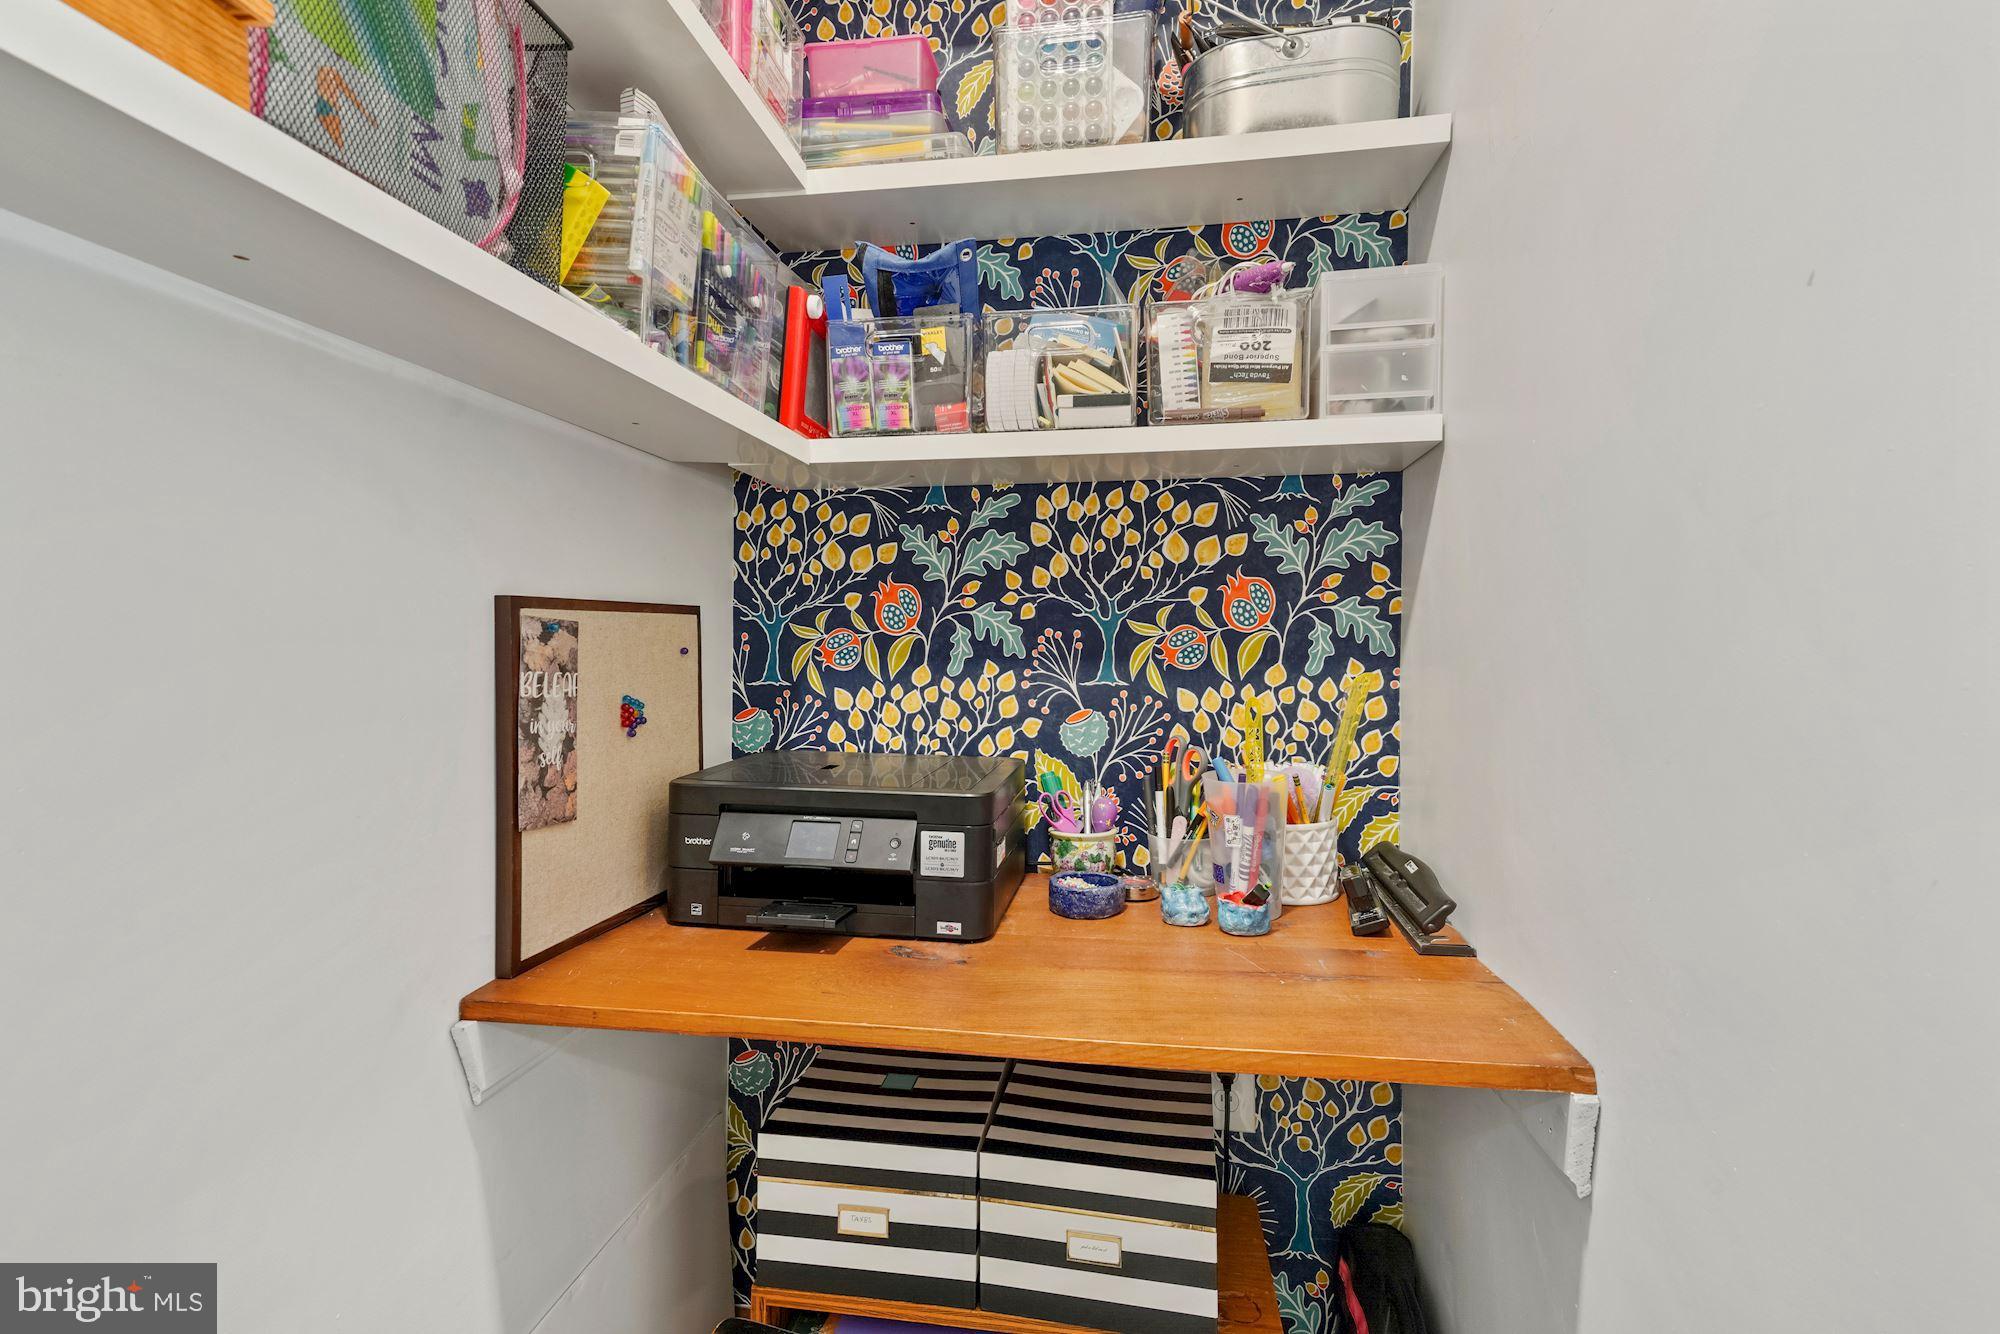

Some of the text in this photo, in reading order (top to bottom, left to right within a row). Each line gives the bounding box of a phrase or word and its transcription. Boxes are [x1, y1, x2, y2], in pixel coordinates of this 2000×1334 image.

[835, 346, 862, 354] brother
[877, 344, 905, 352] brother
[1239, 340, 1272, 351] 200
[1223, 353, 1280, 361] Superior Bond
[529, 718, 577, 741] in your
[539, 745, 564, 771] self
[684, 836, 712, 846] brother
[928, 838, 957, 851] genuine
[850, 1214, 873, 1224] TAXES
